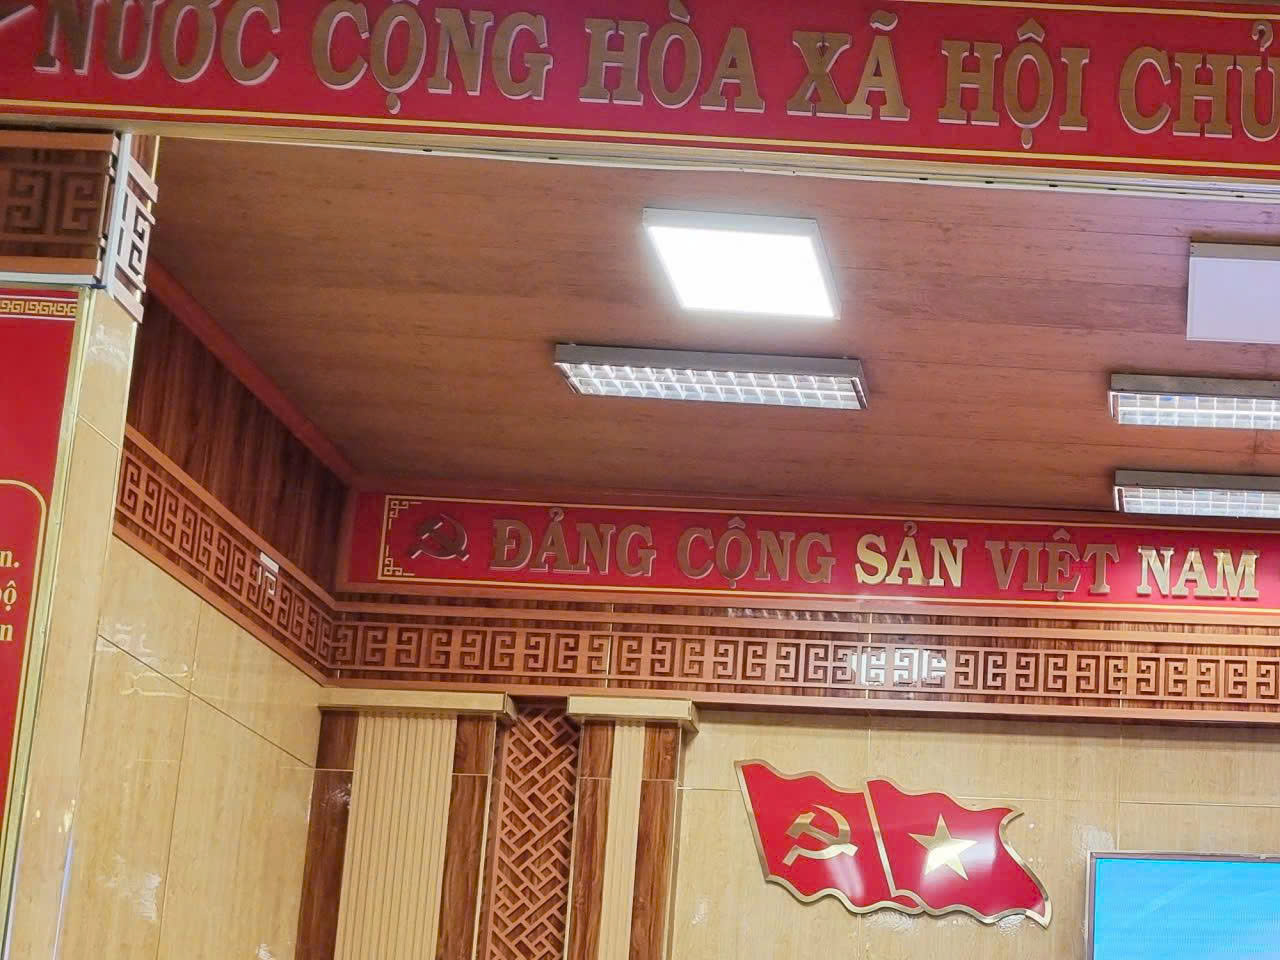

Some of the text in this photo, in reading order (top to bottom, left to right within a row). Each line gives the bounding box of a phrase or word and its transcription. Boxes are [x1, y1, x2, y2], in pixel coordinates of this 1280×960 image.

[311, 0, 553, 114] CỘNG
[579, 0, 765, 113] HÒA
[786, 10, 911, 121] XÃ
[938, 19, 1091, 149] HỘI
[489, 506, 657, 577] ĐẢNG
[676, 517, 837, 589] CỘNG
[854, 520, 968, 589] SẢN
[984, 527, 1120, 600] VIỆT
[1137, 546, 1259, 600] NAM
